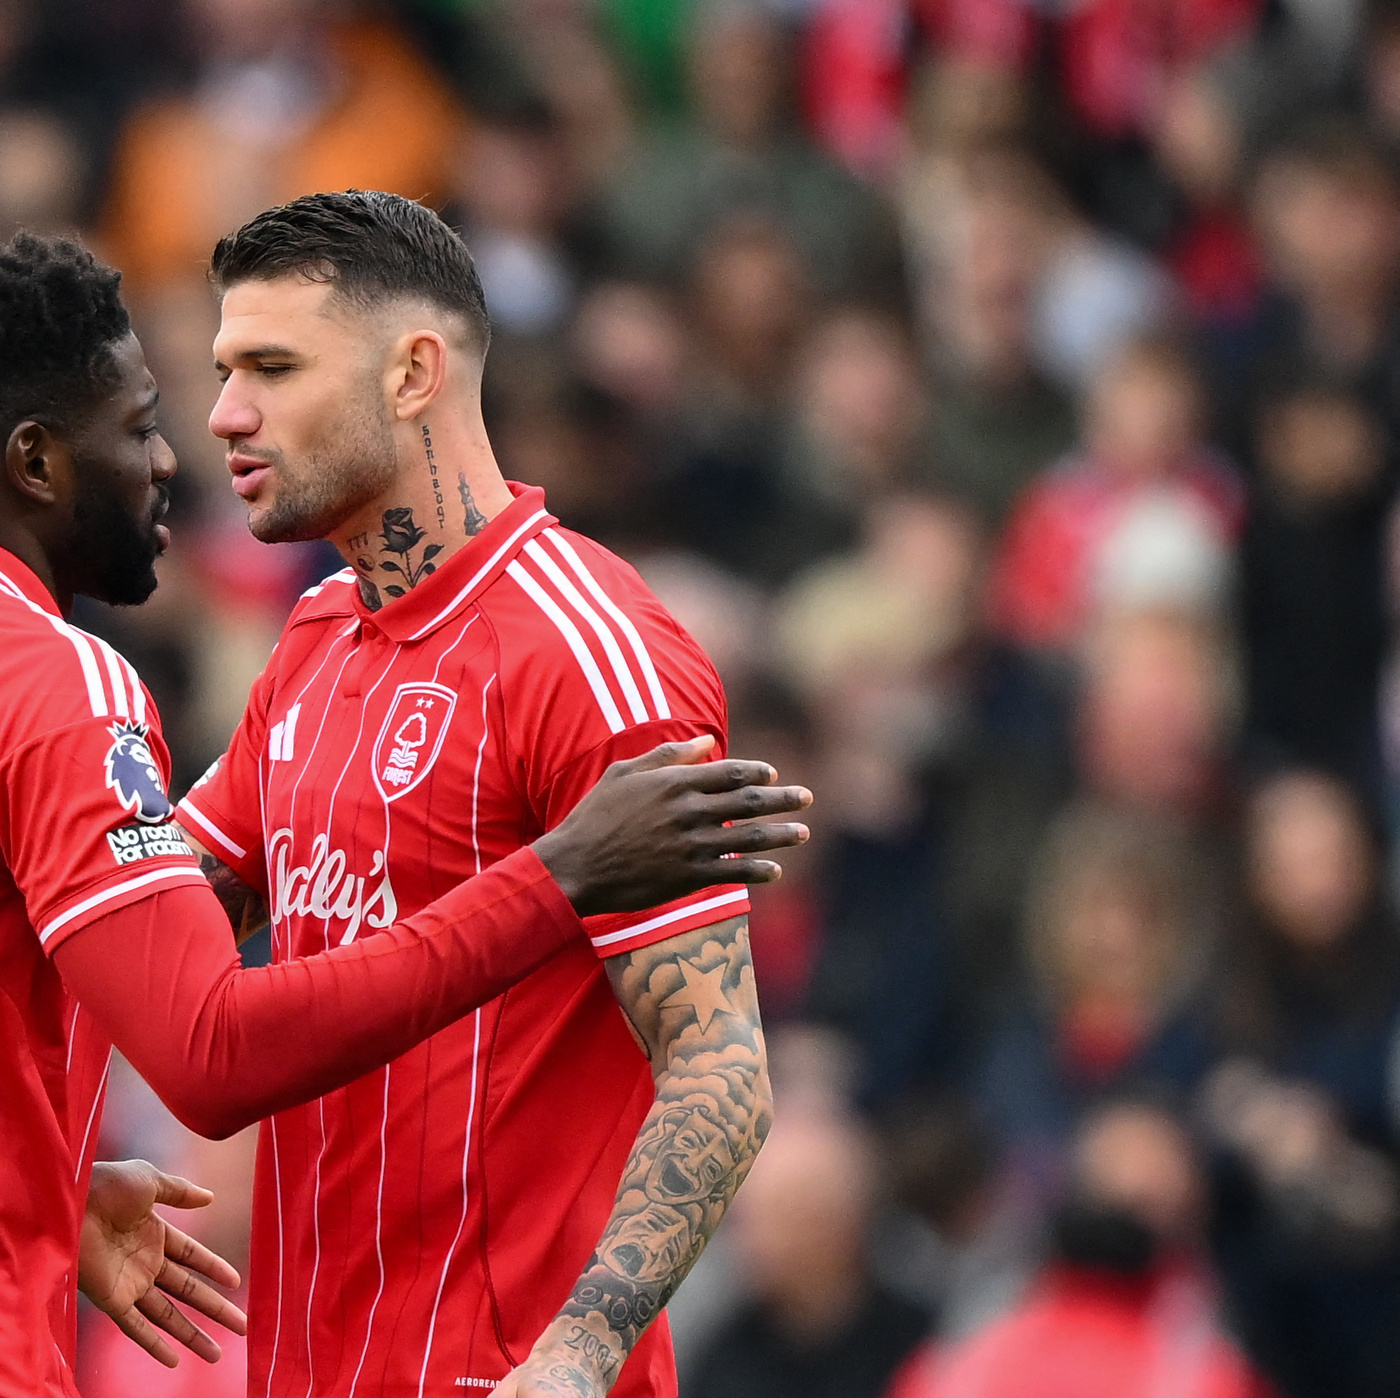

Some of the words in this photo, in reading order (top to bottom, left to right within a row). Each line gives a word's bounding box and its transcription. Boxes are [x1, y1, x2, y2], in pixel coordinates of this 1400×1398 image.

[106, 828, 140, 847] No
[139, 824, 182, 841] room
[112, 845, 144, 866] for
